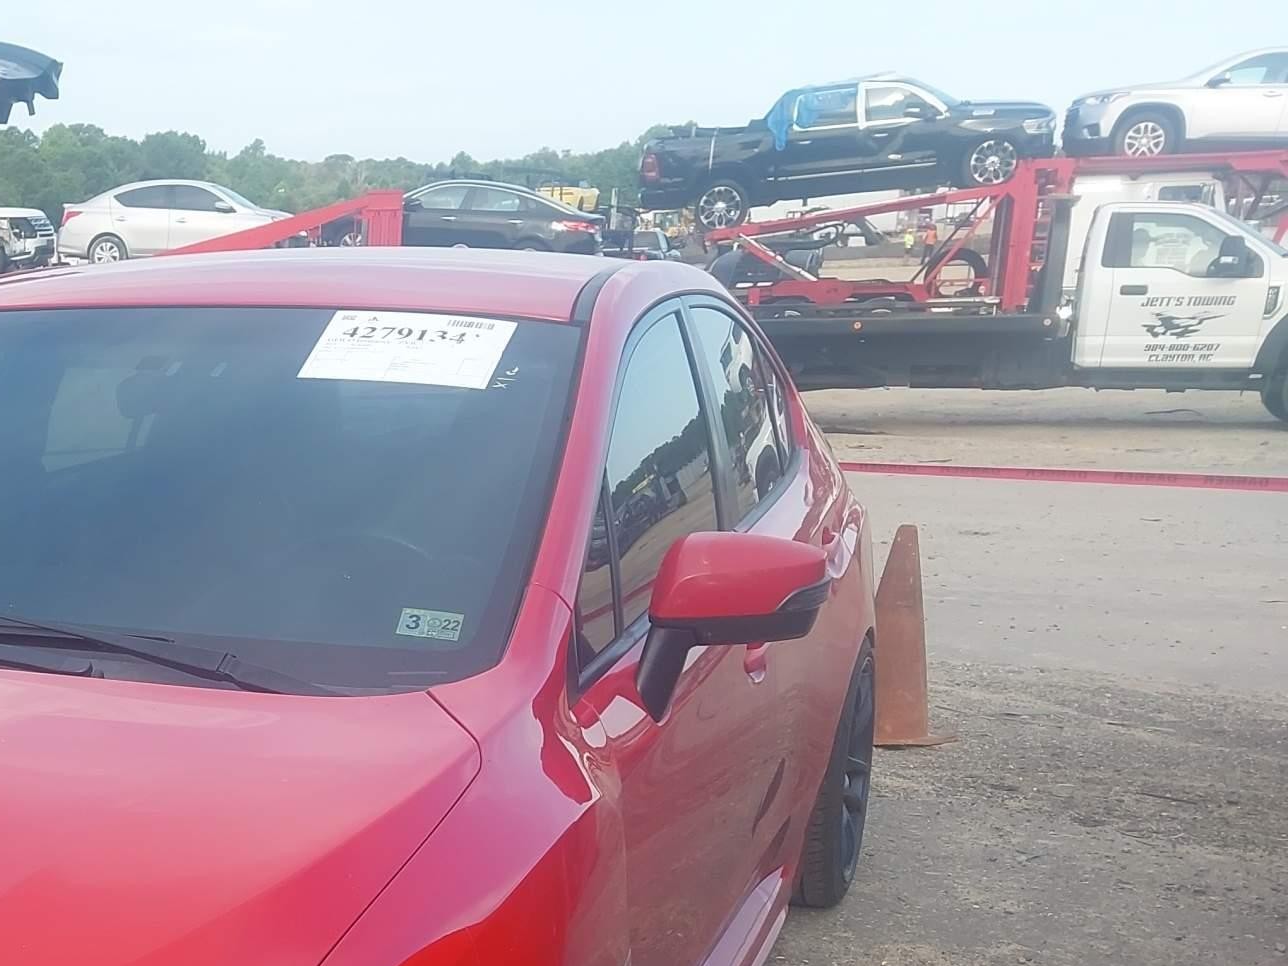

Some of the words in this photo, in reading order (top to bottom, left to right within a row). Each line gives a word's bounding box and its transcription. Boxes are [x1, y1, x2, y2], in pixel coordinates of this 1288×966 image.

[342, 326, 481, 344] 4279134
[406, 614, 421, 630] 3
[441, 618, 461, 631] 22
